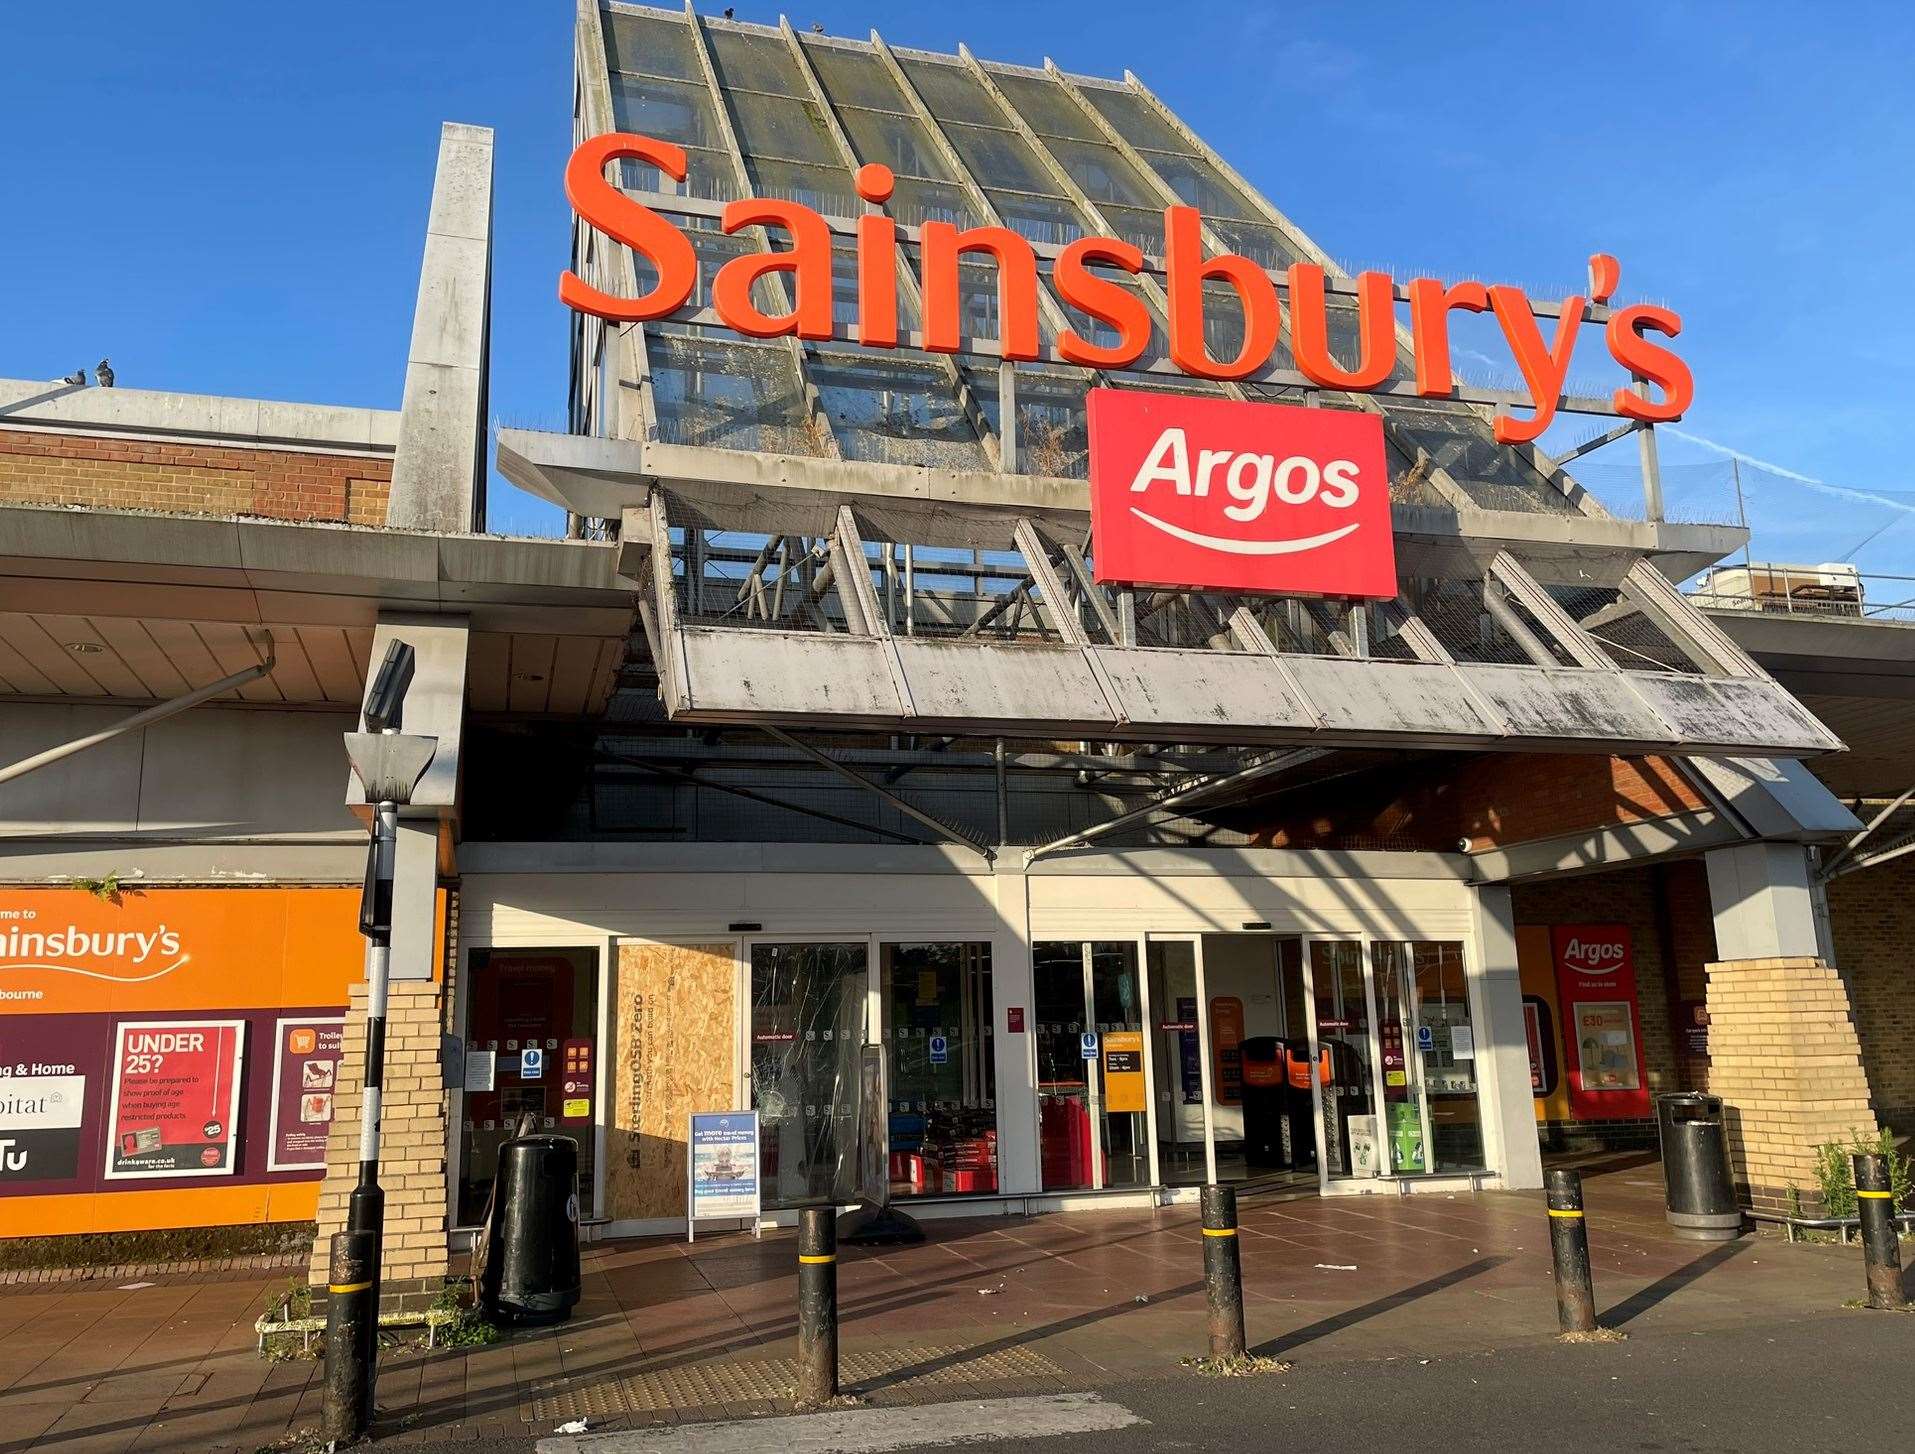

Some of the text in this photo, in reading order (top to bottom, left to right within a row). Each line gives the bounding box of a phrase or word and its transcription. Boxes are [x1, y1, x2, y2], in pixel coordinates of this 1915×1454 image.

[559, 133, 1694, 445] Sainsbury's
[1131, 428, 1359, 522] Argos
[23, 909, 36, 920] to
[1564, 938, 1624, 965] Argos
[632, 993, 644, 1034] Zero
[318, 1031, 343, 1040] Trolle
[127, 1033, 205, 1054] UNDER
[15, 1063, 28, 1076] &
[31, 1063, 75, 1076] Home
[125, 1054, 164, 1074] 25?
[124, 1076, 200, 1085] Please be prepared to
[124, 1089, 142, 1097] show
[142, 1089, 161, 1098] proof
[155, 1113, 186, 1121] products
[117, 1157, 176, 1166] drinkaware.co.uk
